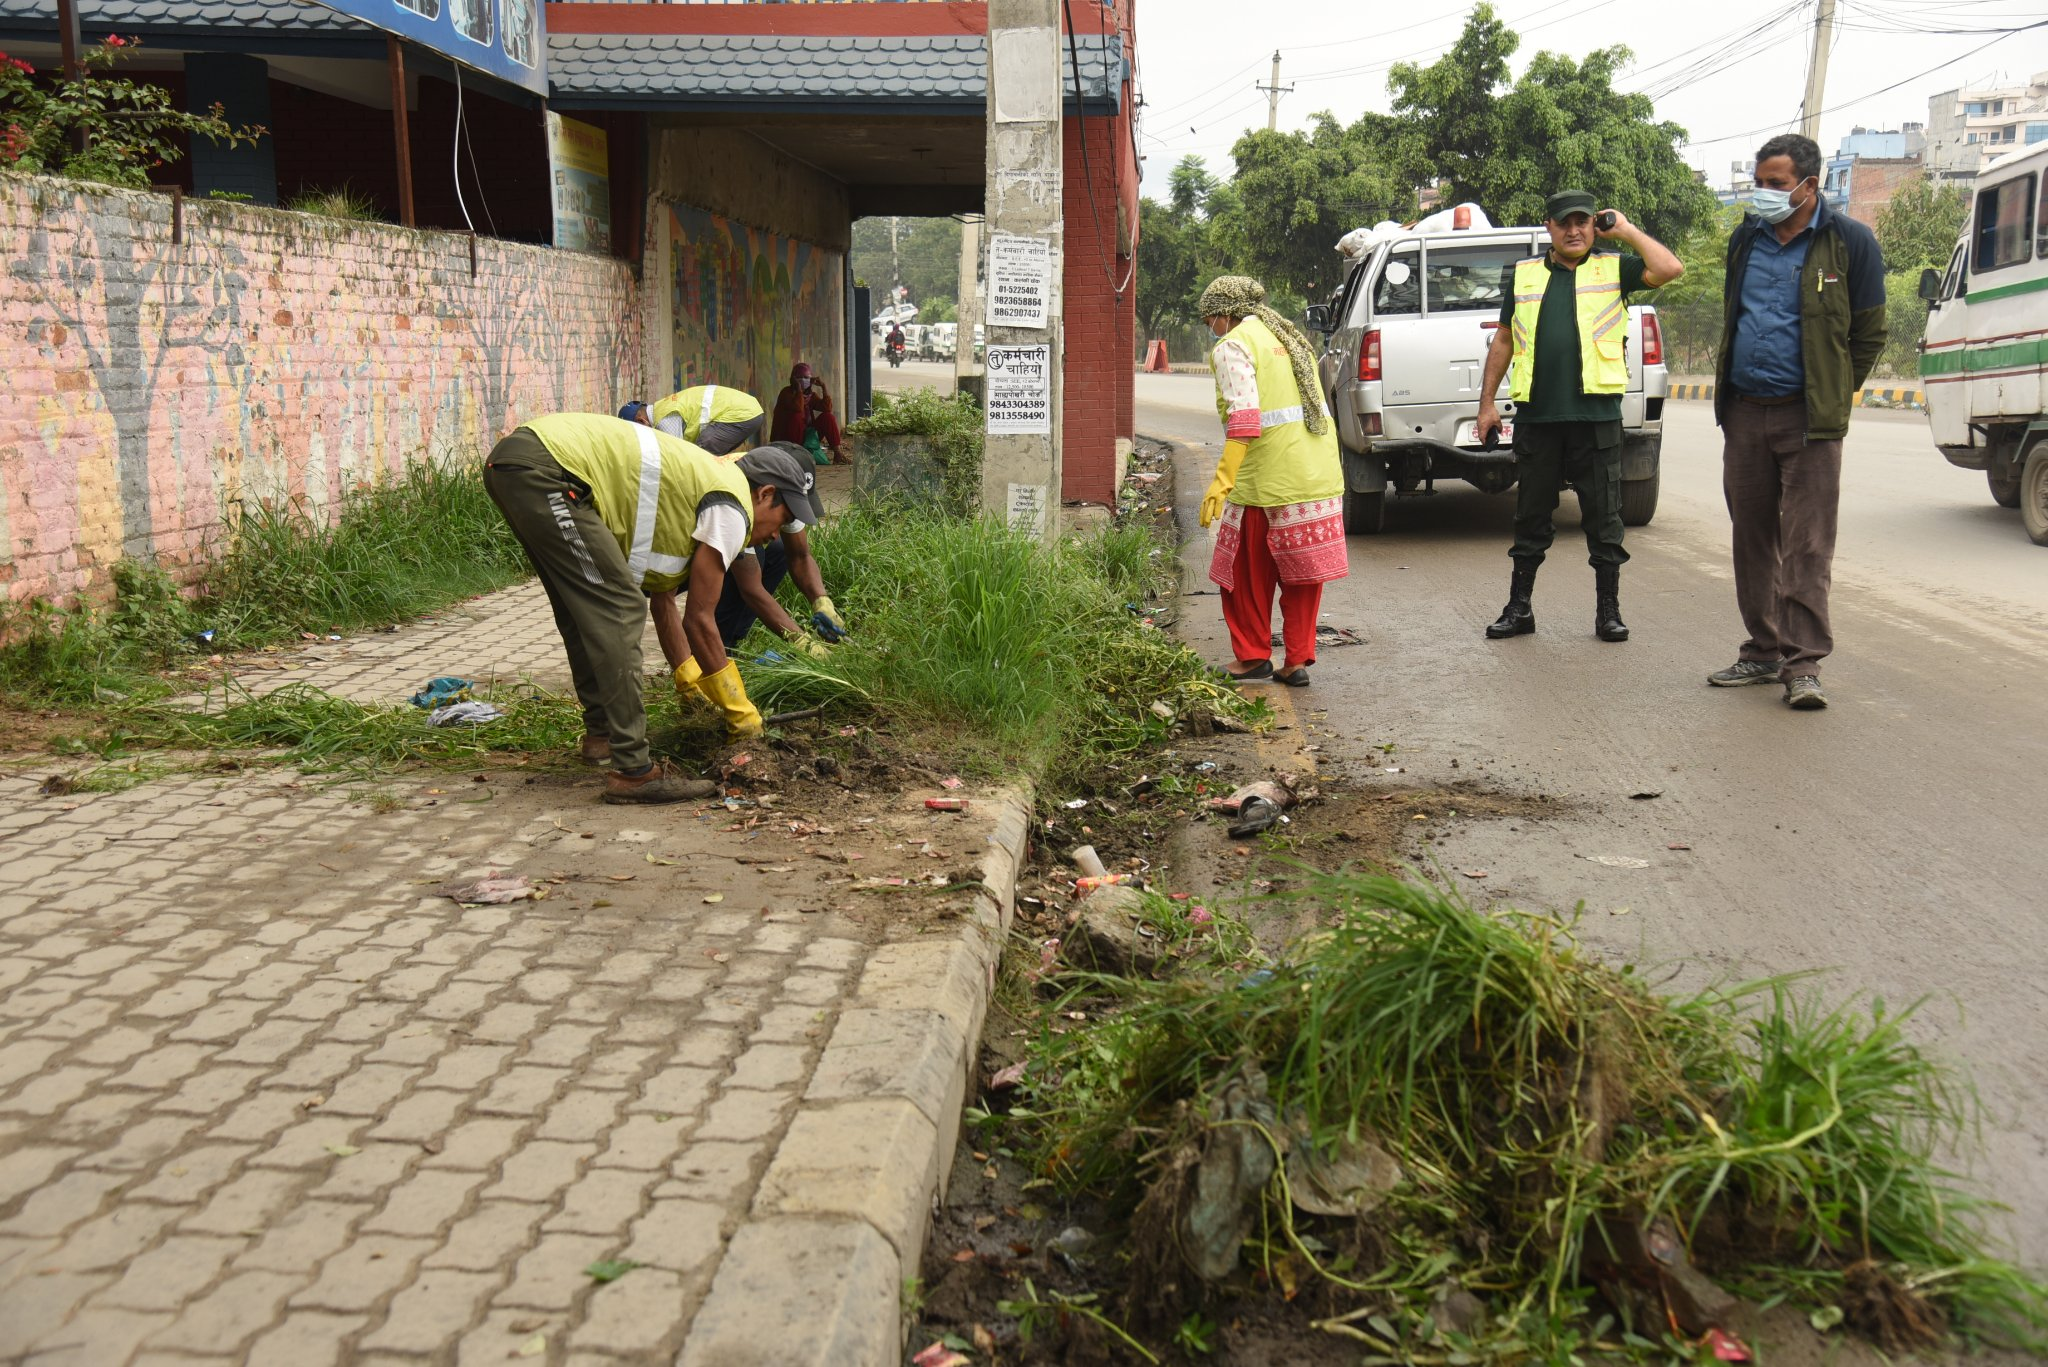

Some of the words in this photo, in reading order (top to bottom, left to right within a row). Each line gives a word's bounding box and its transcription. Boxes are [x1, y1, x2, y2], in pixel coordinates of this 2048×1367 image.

[999, 285, 1038, 294] 01-5225402
[994, 296, 1041, 306] 9823658864
[994, 308, 1040, 317] 9862907437
[1003, 347, 1046, 360] कर्मचारी
[1006, 362, 1043, 376] चाहियो
[547, 491, 576, 530] NIKE
